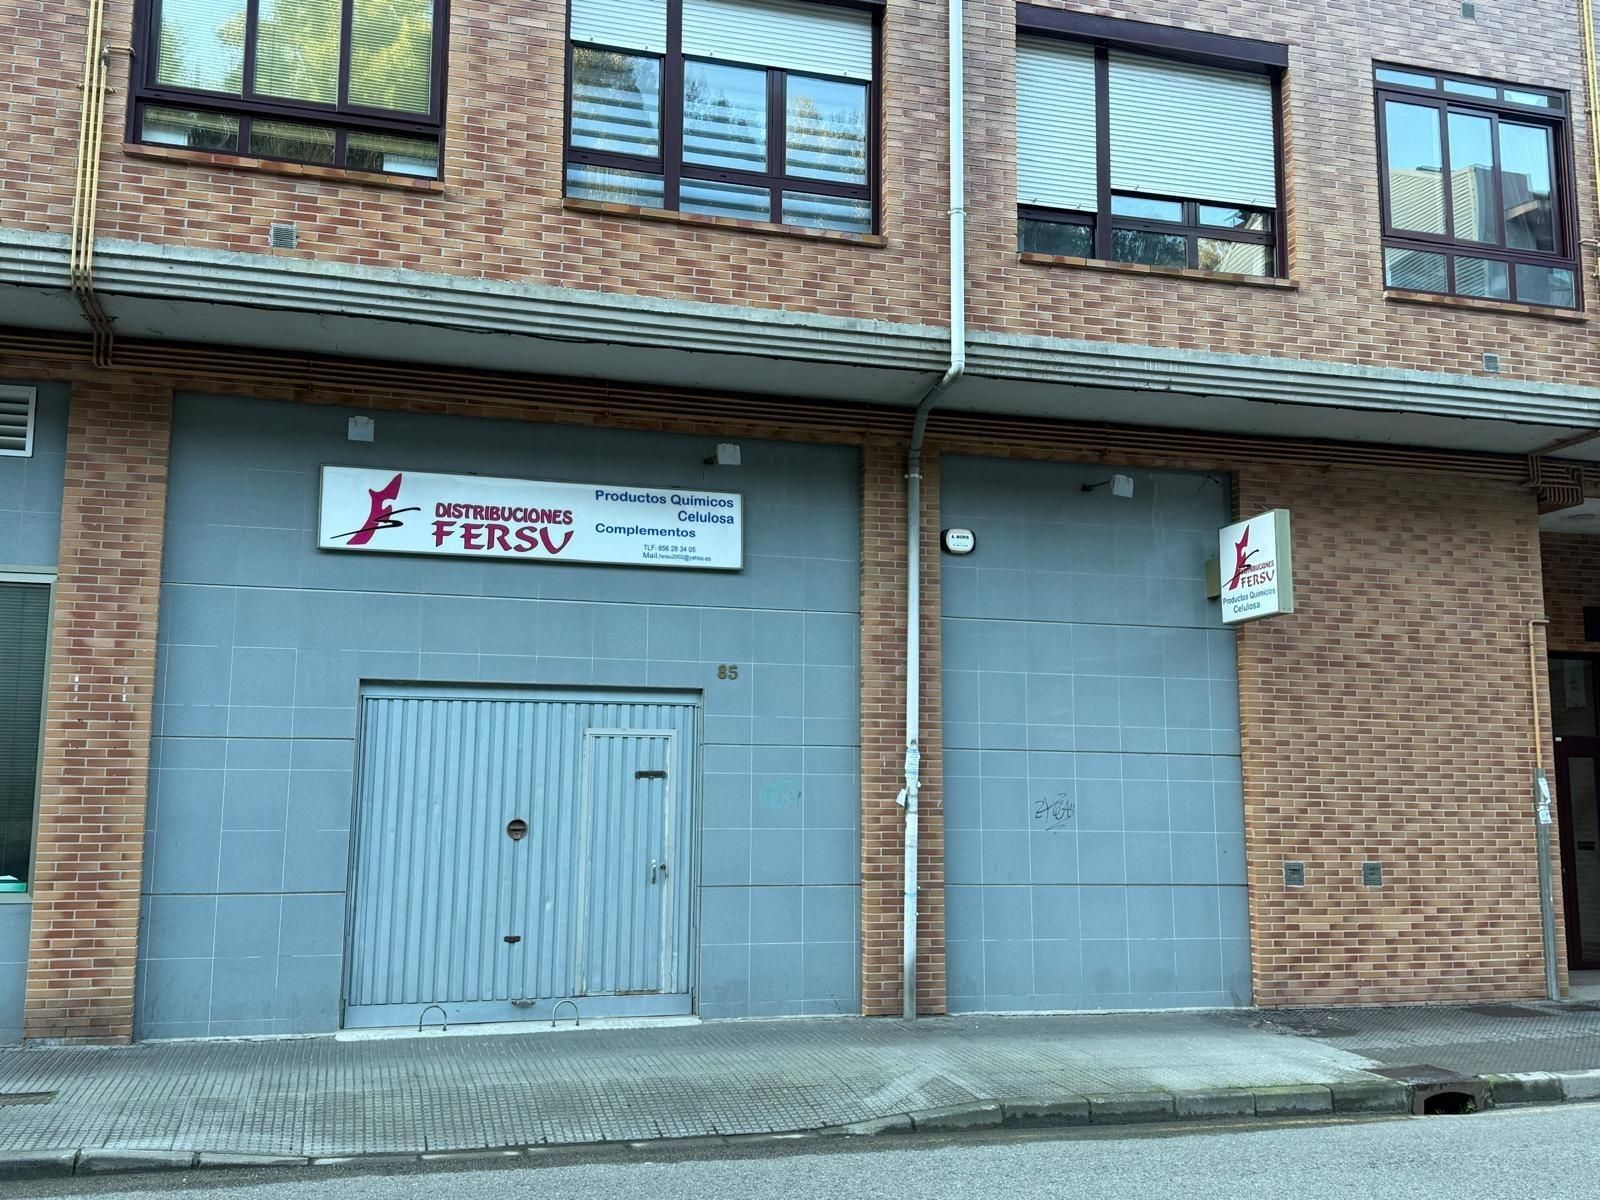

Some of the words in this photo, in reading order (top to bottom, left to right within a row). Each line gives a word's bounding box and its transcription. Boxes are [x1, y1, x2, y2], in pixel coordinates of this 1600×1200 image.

[595, 490, 667, 504] Productos
[670, 494, 734, 508] Químicos
[435, 502, 573, 525] DISTRIBUCIONES
[678, 510, 734, 524] Celulosa
[595, 523, 696, 538] Complementos
[1223, 594, 1248, 605] Productos
[1233, 602, 1260, 613] Celulosa
[717, 664, 738, 680] 85
